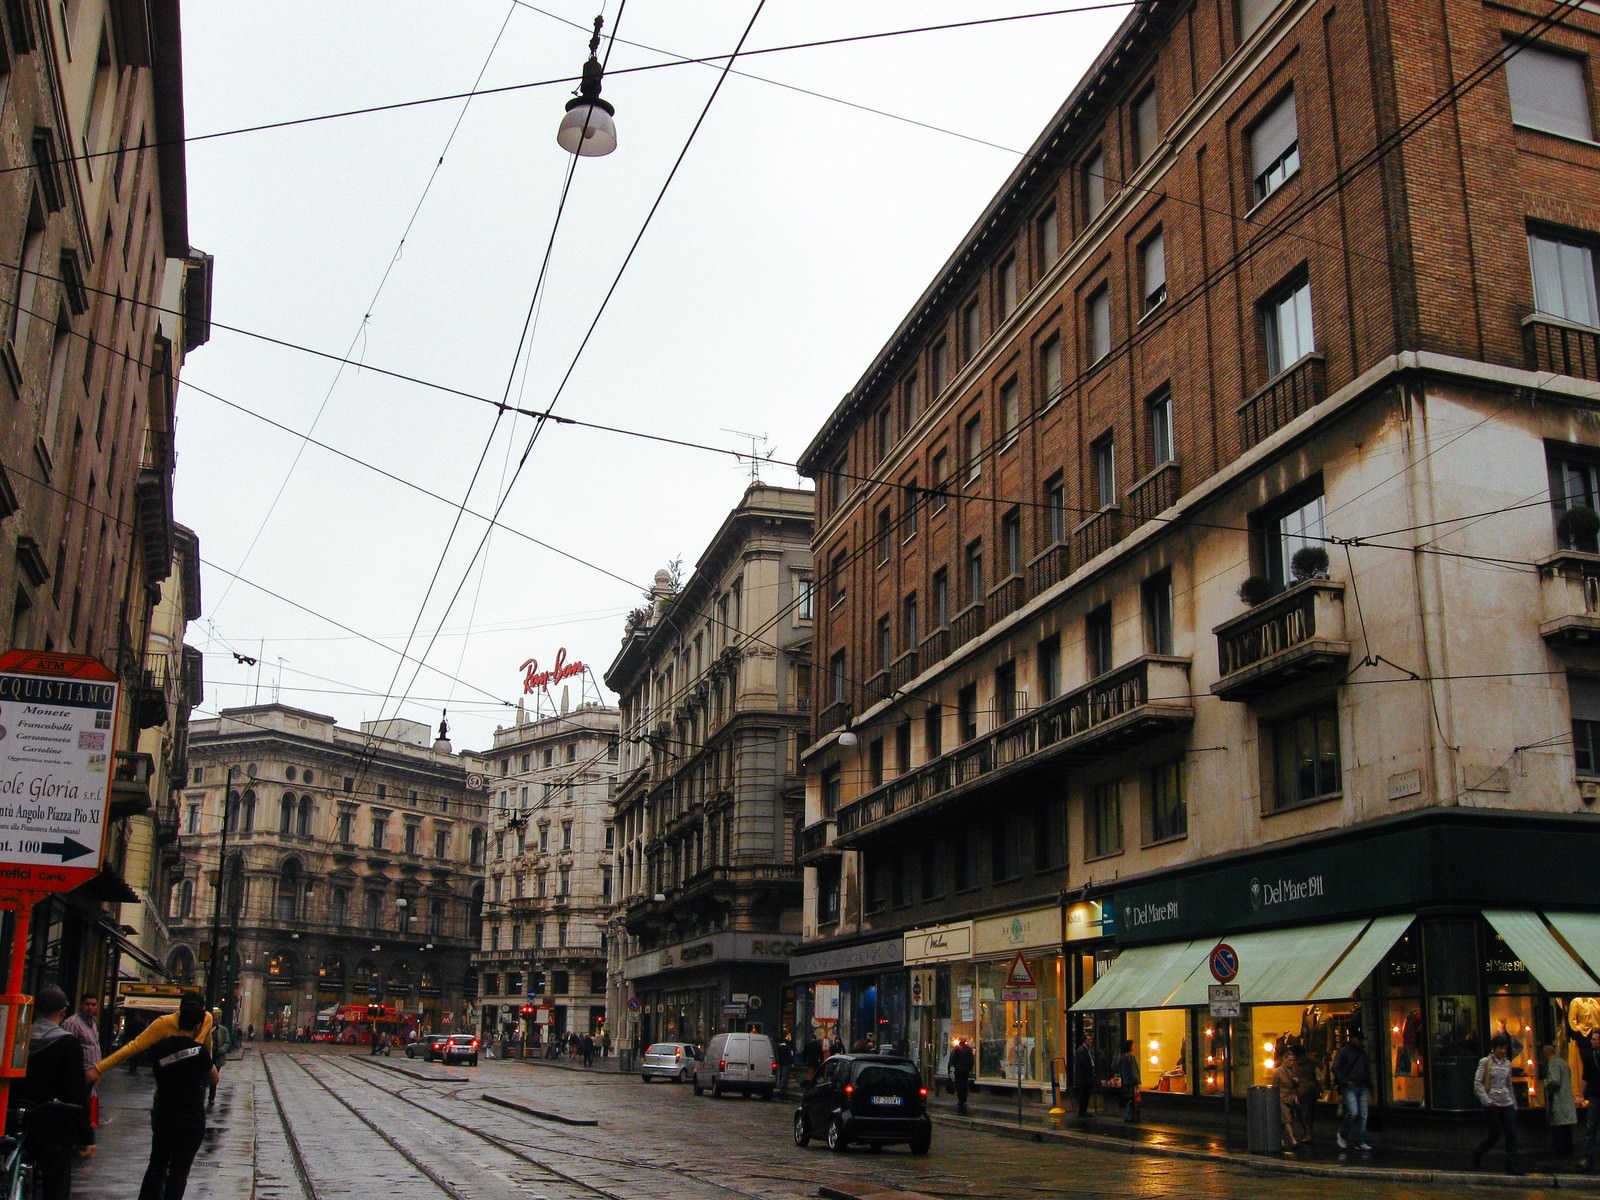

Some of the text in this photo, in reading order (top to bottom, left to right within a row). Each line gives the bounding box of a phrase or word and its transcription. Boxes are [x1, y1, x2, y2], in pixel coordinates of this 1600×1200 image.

[37, 661, 65, 671] ATM
[519, 646, 585, 694] Ray-Ban
[22, 706, 71, 718] Monete
[17, 719, 73, 732] Francobolli
[15, 732, 71, 744] Cartamoneta
[22, 744, 62, 755] Cartoline
[30, 773, 79, 802] Gloria
[16, 804, 45, 824] Angolo
[47, 806, 72, 822] Piazza
[74, 808, 88, 823] Pio
[89, 809, 100, 824] XI
[17, 840, 40, 854] 100
[1264, 875, 1323, 905] Del Mare 1911
[1133, 905, 1148, 926] Del
[1148, 903, 1167, 923] Mare
[1167, 901, 1179, 920] 1911
